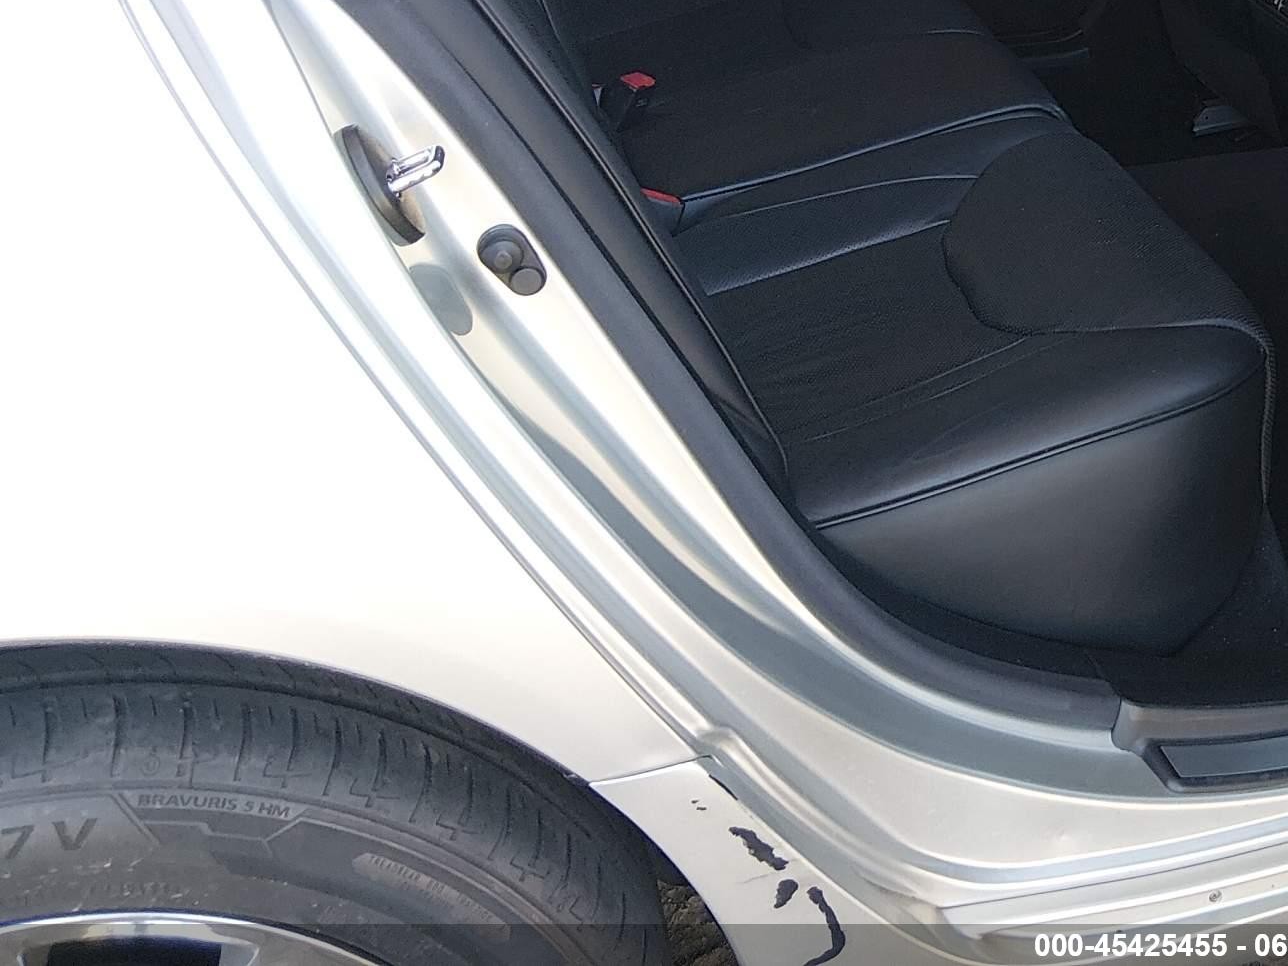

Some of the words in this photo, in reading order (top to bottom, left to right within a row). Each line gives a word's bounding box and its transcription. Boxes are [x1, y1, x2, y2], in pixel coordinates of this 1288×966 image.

[137, 794, 237, 811] BRAVURIS
[244, 801, 255, 812] 5
[258, 802, 290, 818] HM
[52, 818, 98, 850] V
